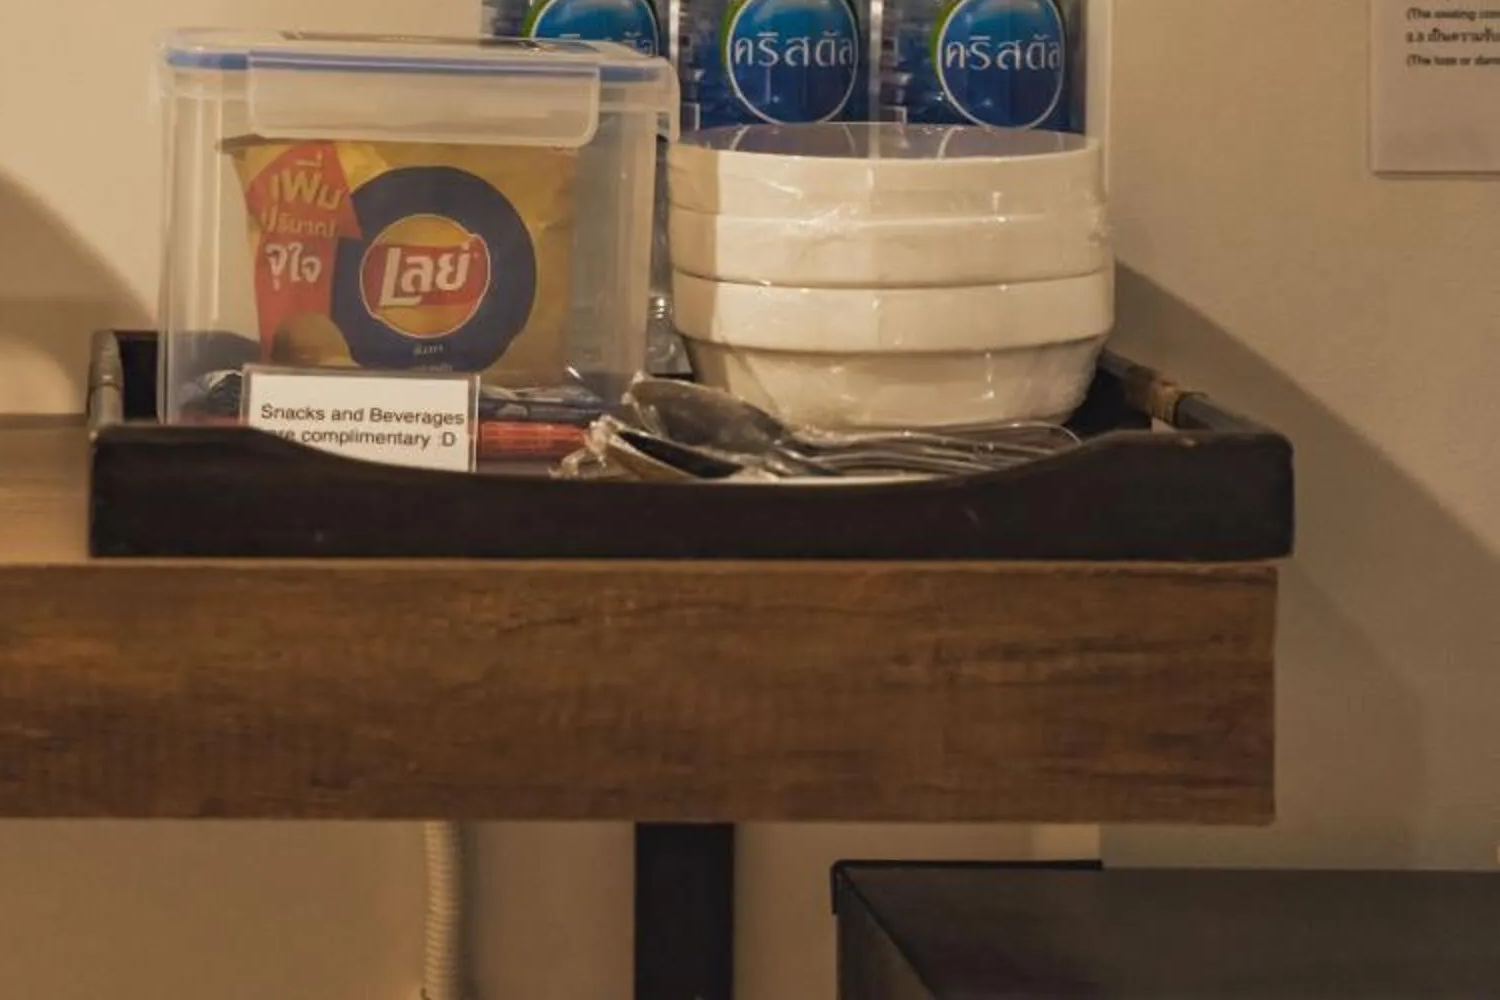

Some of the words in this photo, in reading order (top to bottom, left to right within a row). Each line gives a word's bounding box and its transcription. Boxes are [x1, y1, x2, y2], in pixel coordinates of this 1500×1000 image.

[261, 403, 325, 421] Snacks
[331, 407, 365, 422] and
[369, 407, 465, 428] Beverages
[301, 427, 431, 452] complimentary
